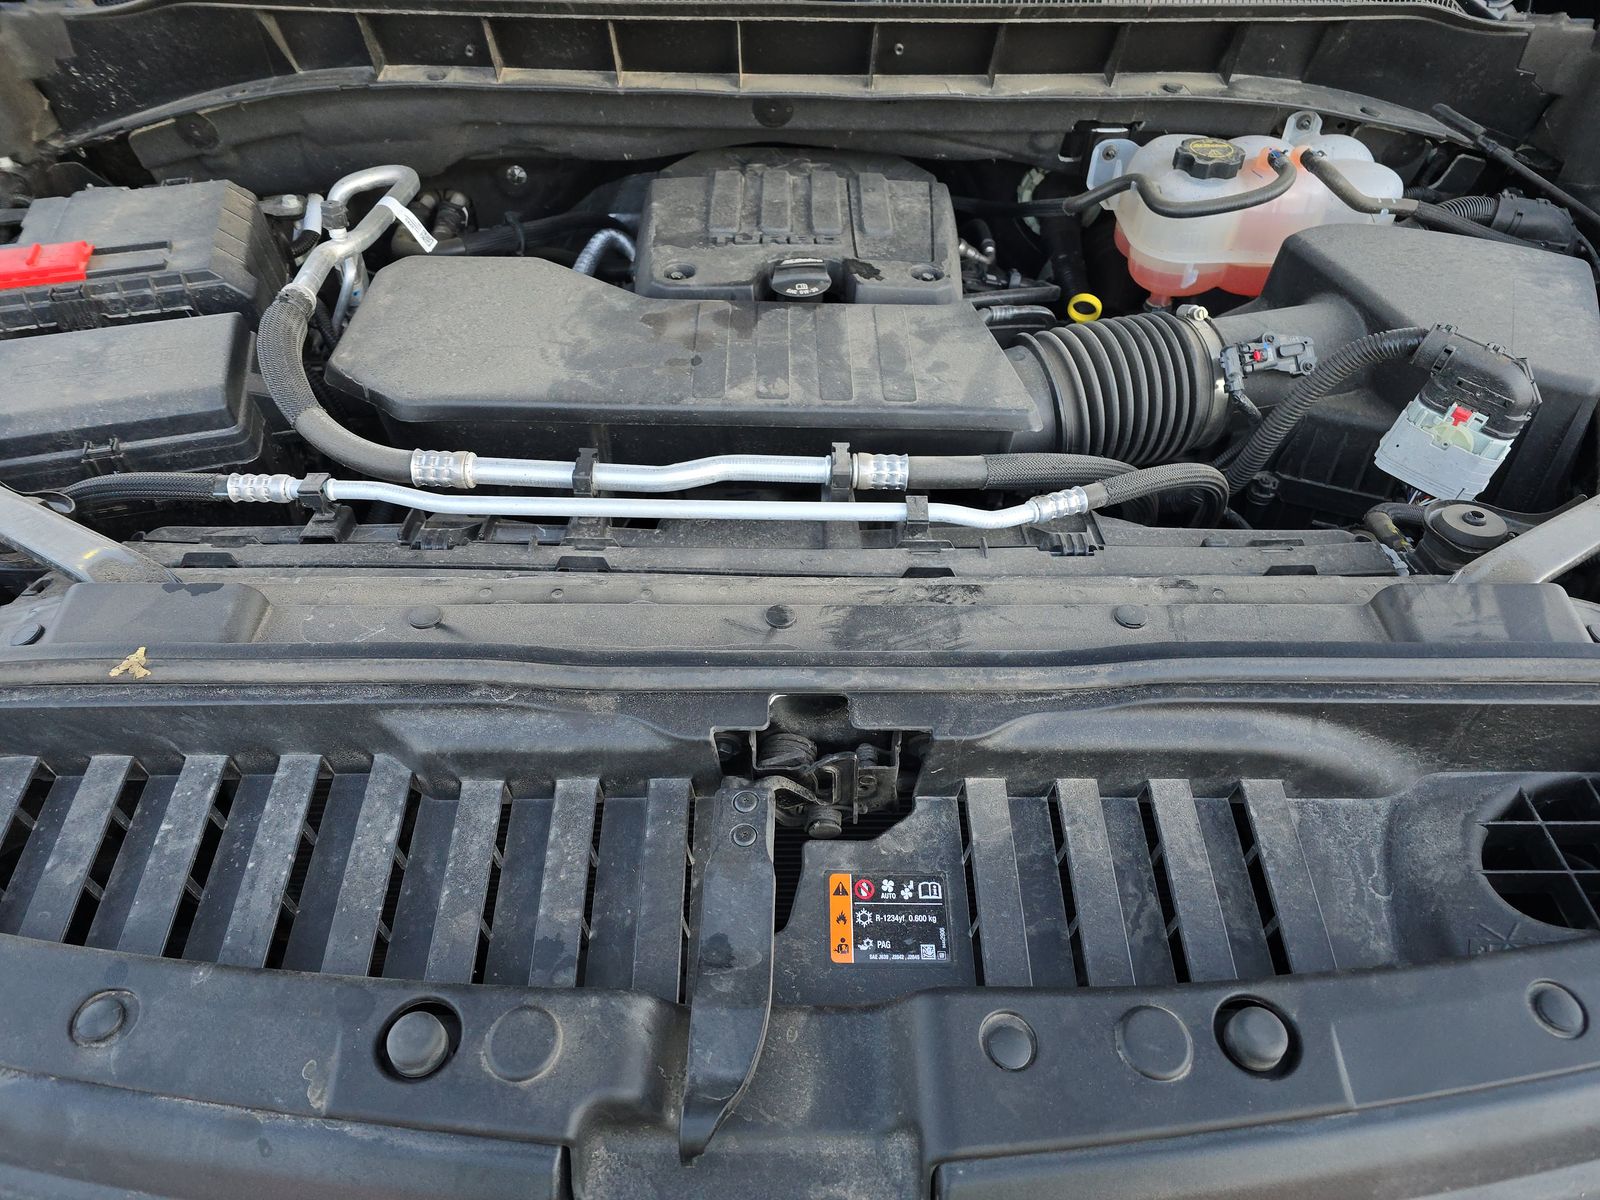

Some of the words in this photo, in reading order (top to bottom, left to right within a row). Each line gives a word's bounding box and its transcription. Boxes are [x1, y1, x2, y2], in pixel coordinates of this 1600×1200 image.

[875, 914, 905, 923] R-1234yf
[908, 914, 927, 922] 0.600
[928, 914, 937, 924] kg
[877, 940, 891, 949] PAG
